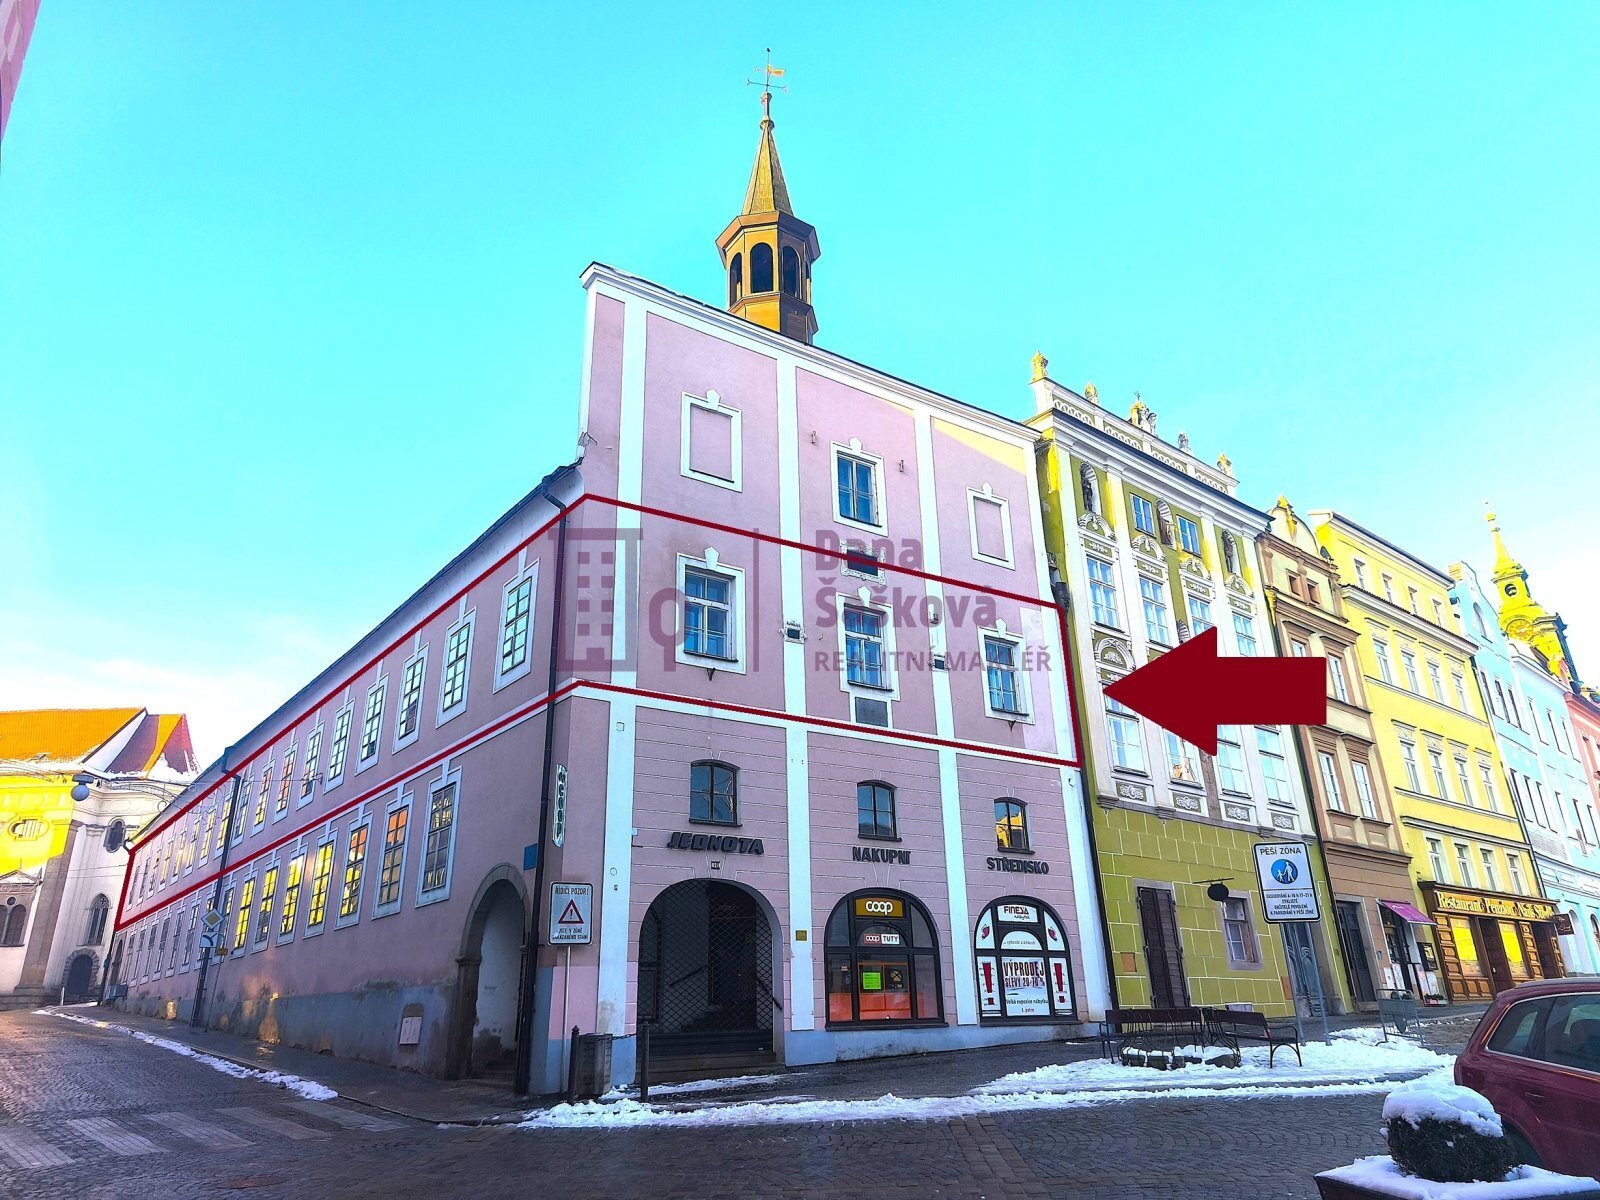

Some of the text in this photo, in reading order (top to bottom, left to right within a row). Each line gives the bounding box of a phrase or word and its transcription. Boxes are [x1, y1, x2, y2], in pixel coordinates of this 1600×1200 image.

[667, 832, 764, 855] JEDNOTA
[1260, 846, 1302, 856] PĚŠÍ ZÓNA
[986, 856, 1050, 875] STŘEDISKO
[866, 901, 893, 915] coop
[1437, 892, 1482, 913] Restaurant
[1003, 959, 1045, 977] VÝPRODEJ
[1004, 977, 1021, 988] SLEVY
